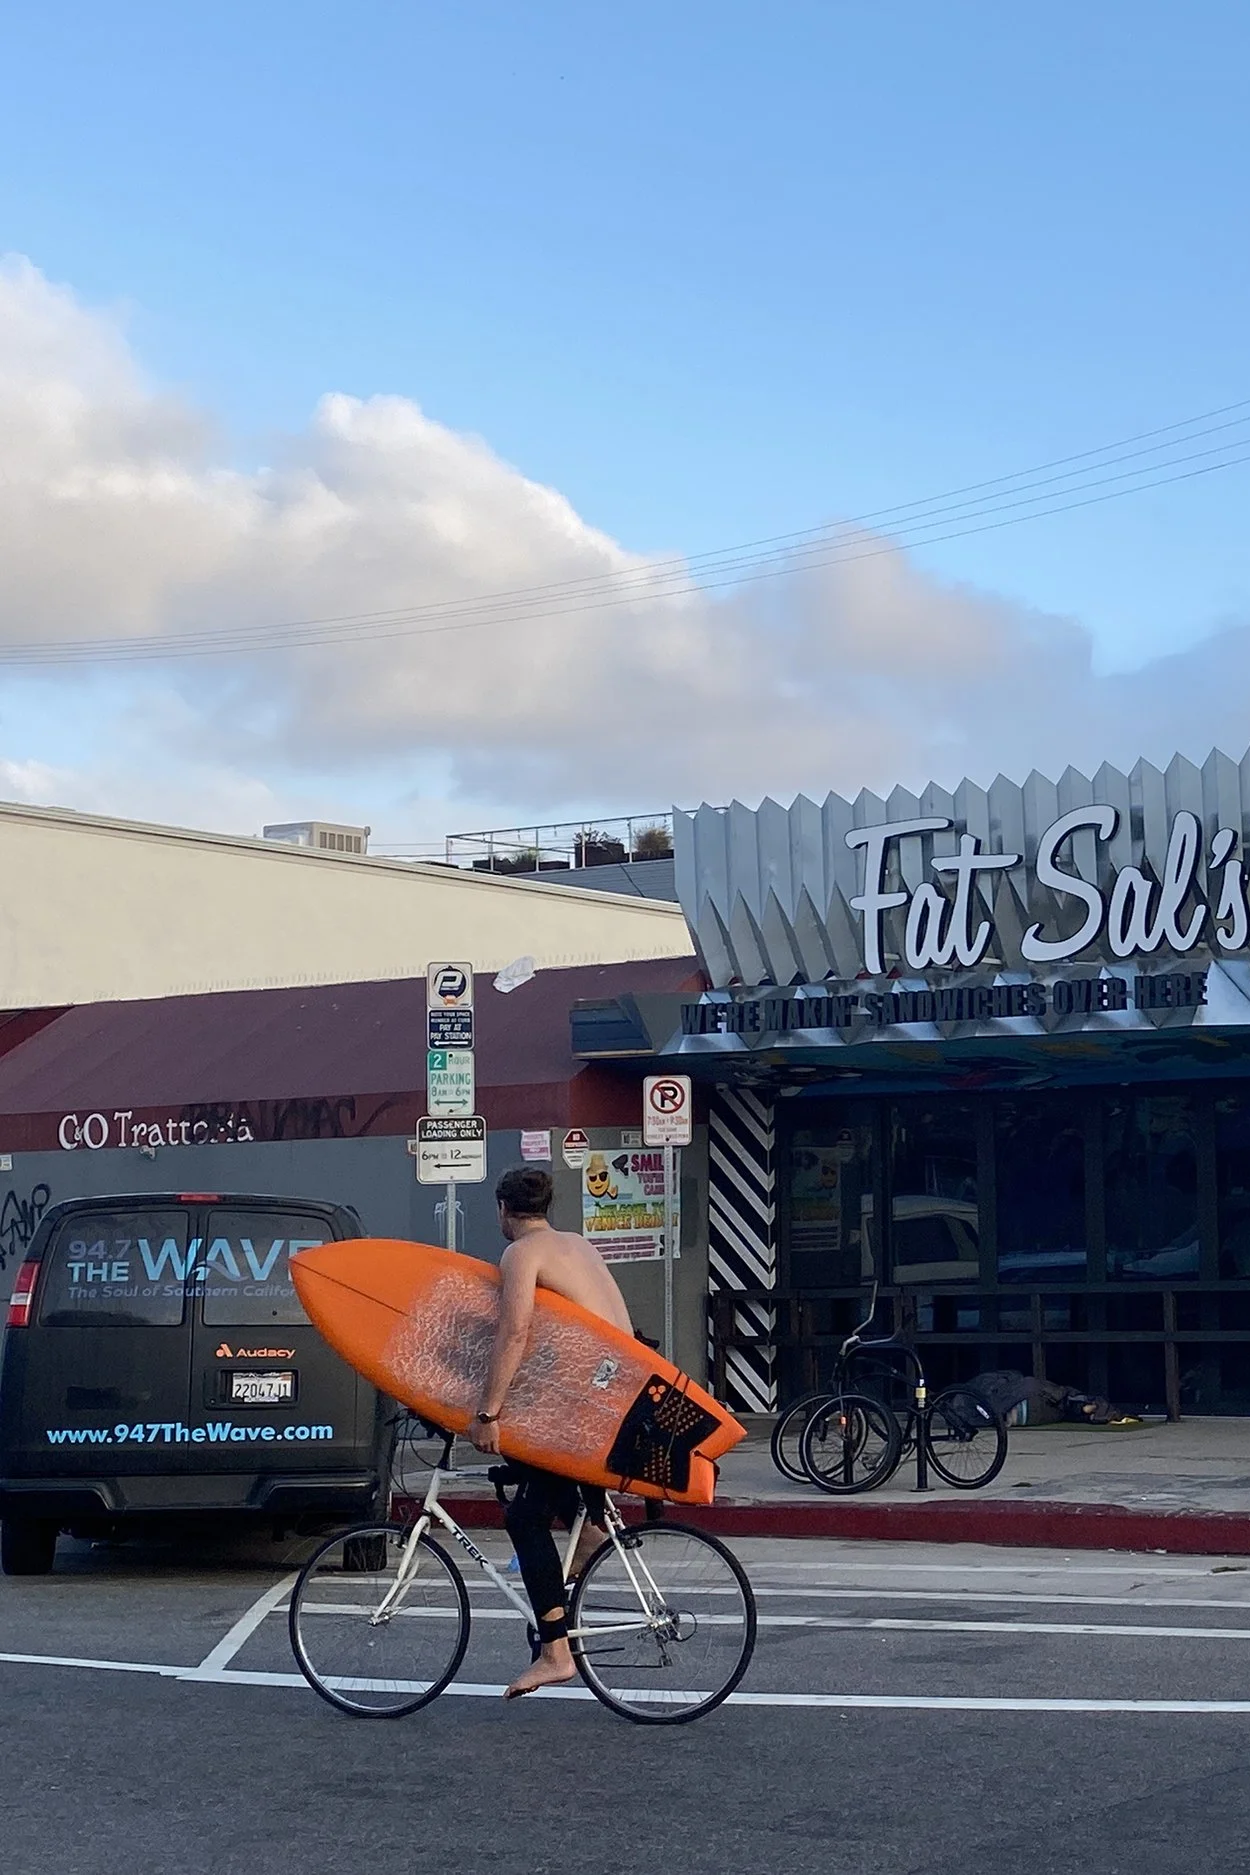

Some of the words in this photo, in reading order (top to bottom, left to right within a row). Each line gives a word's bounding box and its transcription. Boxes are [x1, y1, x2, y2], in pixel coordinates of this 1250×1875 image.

[844, 815, 1024, 975] Fat
[864, 982, 1047, 1027] SANDWICHES
[1052, 976, 1128, 1015] OVER
[1134, 971, 1209, 1010] HERE
[439, 1023, 452, 1031] PAY
[430, 1031, 443, 1040] PAY
[444, 1031, 472, 1041] STATION
[433, 1053, 443, 1069] 2
[430, 1073, 471, 1086] PARKING
[426, 1120, 478, 1130] PASSENGER
[421, 1129, 458, 1140] LOADING
[460, 1128, 483, 1138] ONLY
[631, 1153, 672, 1172] SMIL
[68, 1239, 132, 1260] 94.7
[67, 1261, 131, 1283] THE
[68, 1286, 97, 1299] The
[101, 1285, 139, 1299] Soul
[142, 1284, 158, 1298] of
[162, 1284, 238, 1298] Southern
[236, 1347, 296, 1359] Audacy
[46, 1422, 334, 1444] www.947TheWave.com
[452, 1525, 489, 1569] TREK
